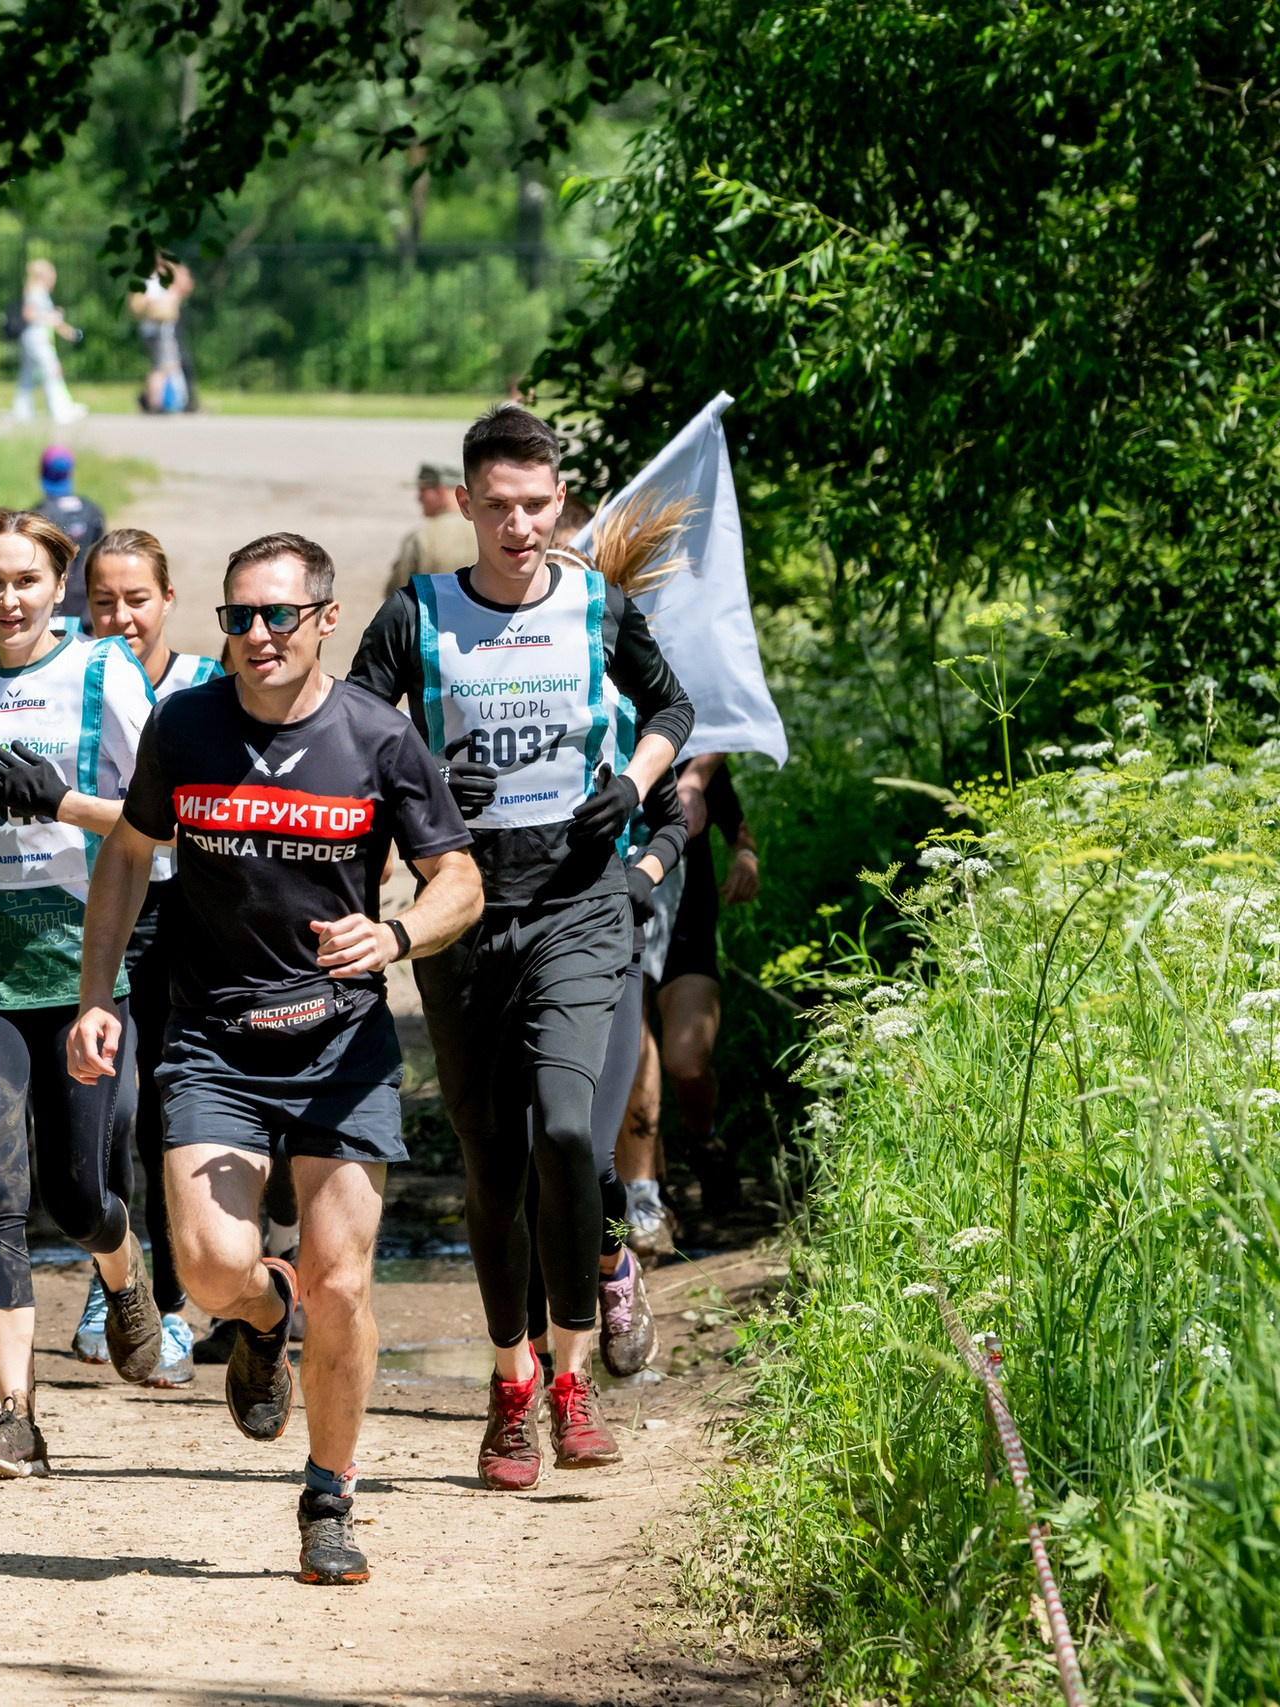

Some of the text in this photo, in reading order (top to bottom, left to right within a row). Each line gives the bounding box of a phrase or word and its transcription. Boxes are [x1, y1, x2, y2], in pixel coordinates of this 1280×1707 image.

[478, 635, 551, 648] ГОНКА ГЕРОЕВ
[454, 672, 579, 684] АКЦИОНЕРНОЕ ОБЩЕСТВО
[12, 699, 46, 709] ГЕРОЕВ
[467, 723, 568, 768] 6037
[500, 790, 559, 805] ГАЗПРОМБАНК
[179, 794, 366, 832] ИНСТРУКТОР
[266, 839, 358, 863] ГЕРОЕВ
[250, 997, 325, 1020] ИНСТРУКТОР
[251, 1008, 327, 1030] ГОНКА ГЕРОЕВ
